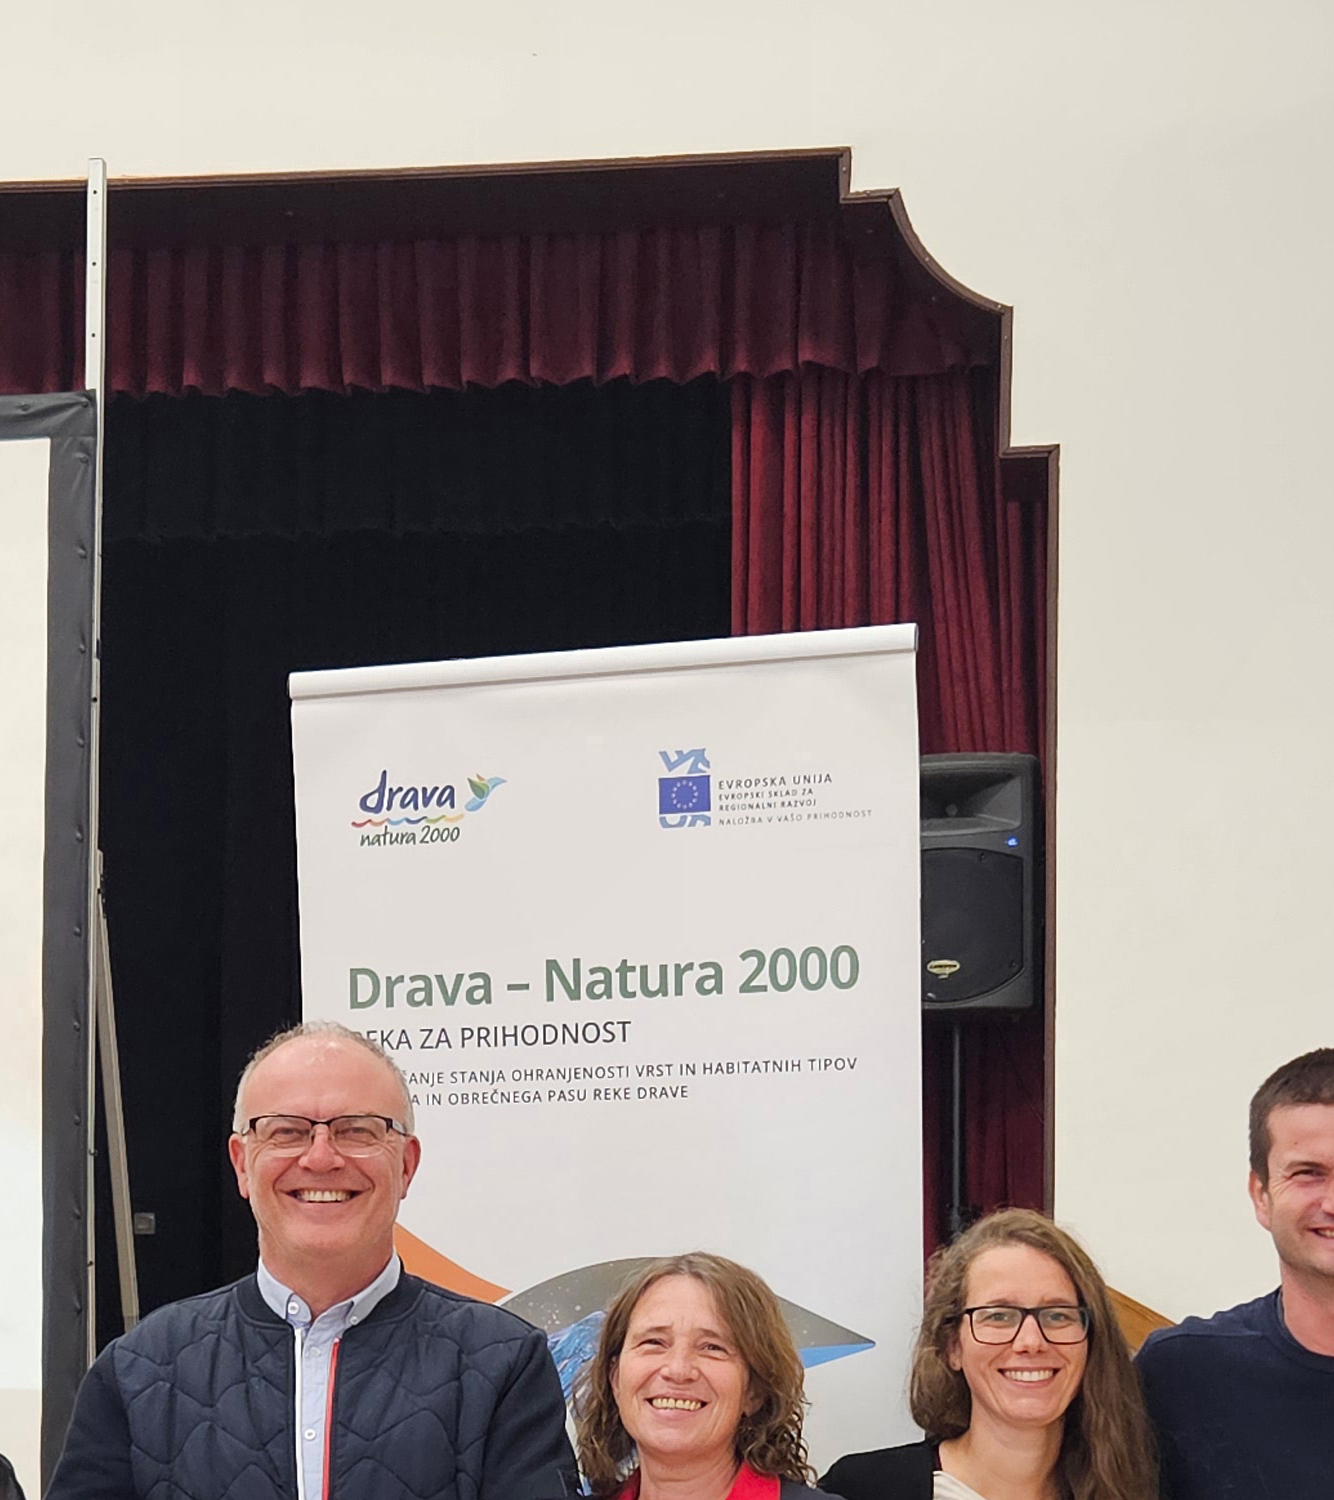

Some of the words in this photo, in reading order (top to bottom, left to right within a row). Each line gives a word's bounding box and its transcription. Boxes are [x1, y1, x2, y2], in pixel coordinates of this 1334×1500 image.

[359, 769, 455, 814] drava
[718, 776, 787, 790] EVROPSKA
[792, 773, 833, 785] UNIJA
[718, 792, 765, 802] EVROPSKI
[768, 788, 798, 798] SKLAD
[801, 787, 814, 796] ZA
[718, 802, 777, 812] REGIONALNI
[780, 799, 817, 808] RAZVOJ
[360, 825, 416, 847] natura
[419, 825, 460, 844] 2000
[349, 967, 492, 1010] Drava
[545, 956, 724, 1002] Natura
[738, 944, 861, 994] 2000
[419, 1027, 452, 1050] ZA
[461, 1020, 632, 1049] PRIHODNOST
[450, 1068, 507, 1086] STANJA
[511, 1064, 631, 1084] OHRANJENOSTI
[635, 1063, 674, 1078] VRST
[679, 1062, 697, 1076] IN
[702, 1058, 802, 1075] HABITATNIH
[807, 1056, 858, 1071] TIPOV
[426, 1092, 443, 1106] IN
[448, 1087, 542, 1106] OBREČNEGA
[548, 1089, 588, 1104] PASU
[593, 1087, 632, 1101] REKE
[636, 1085, 689, 1100] DRAVE
